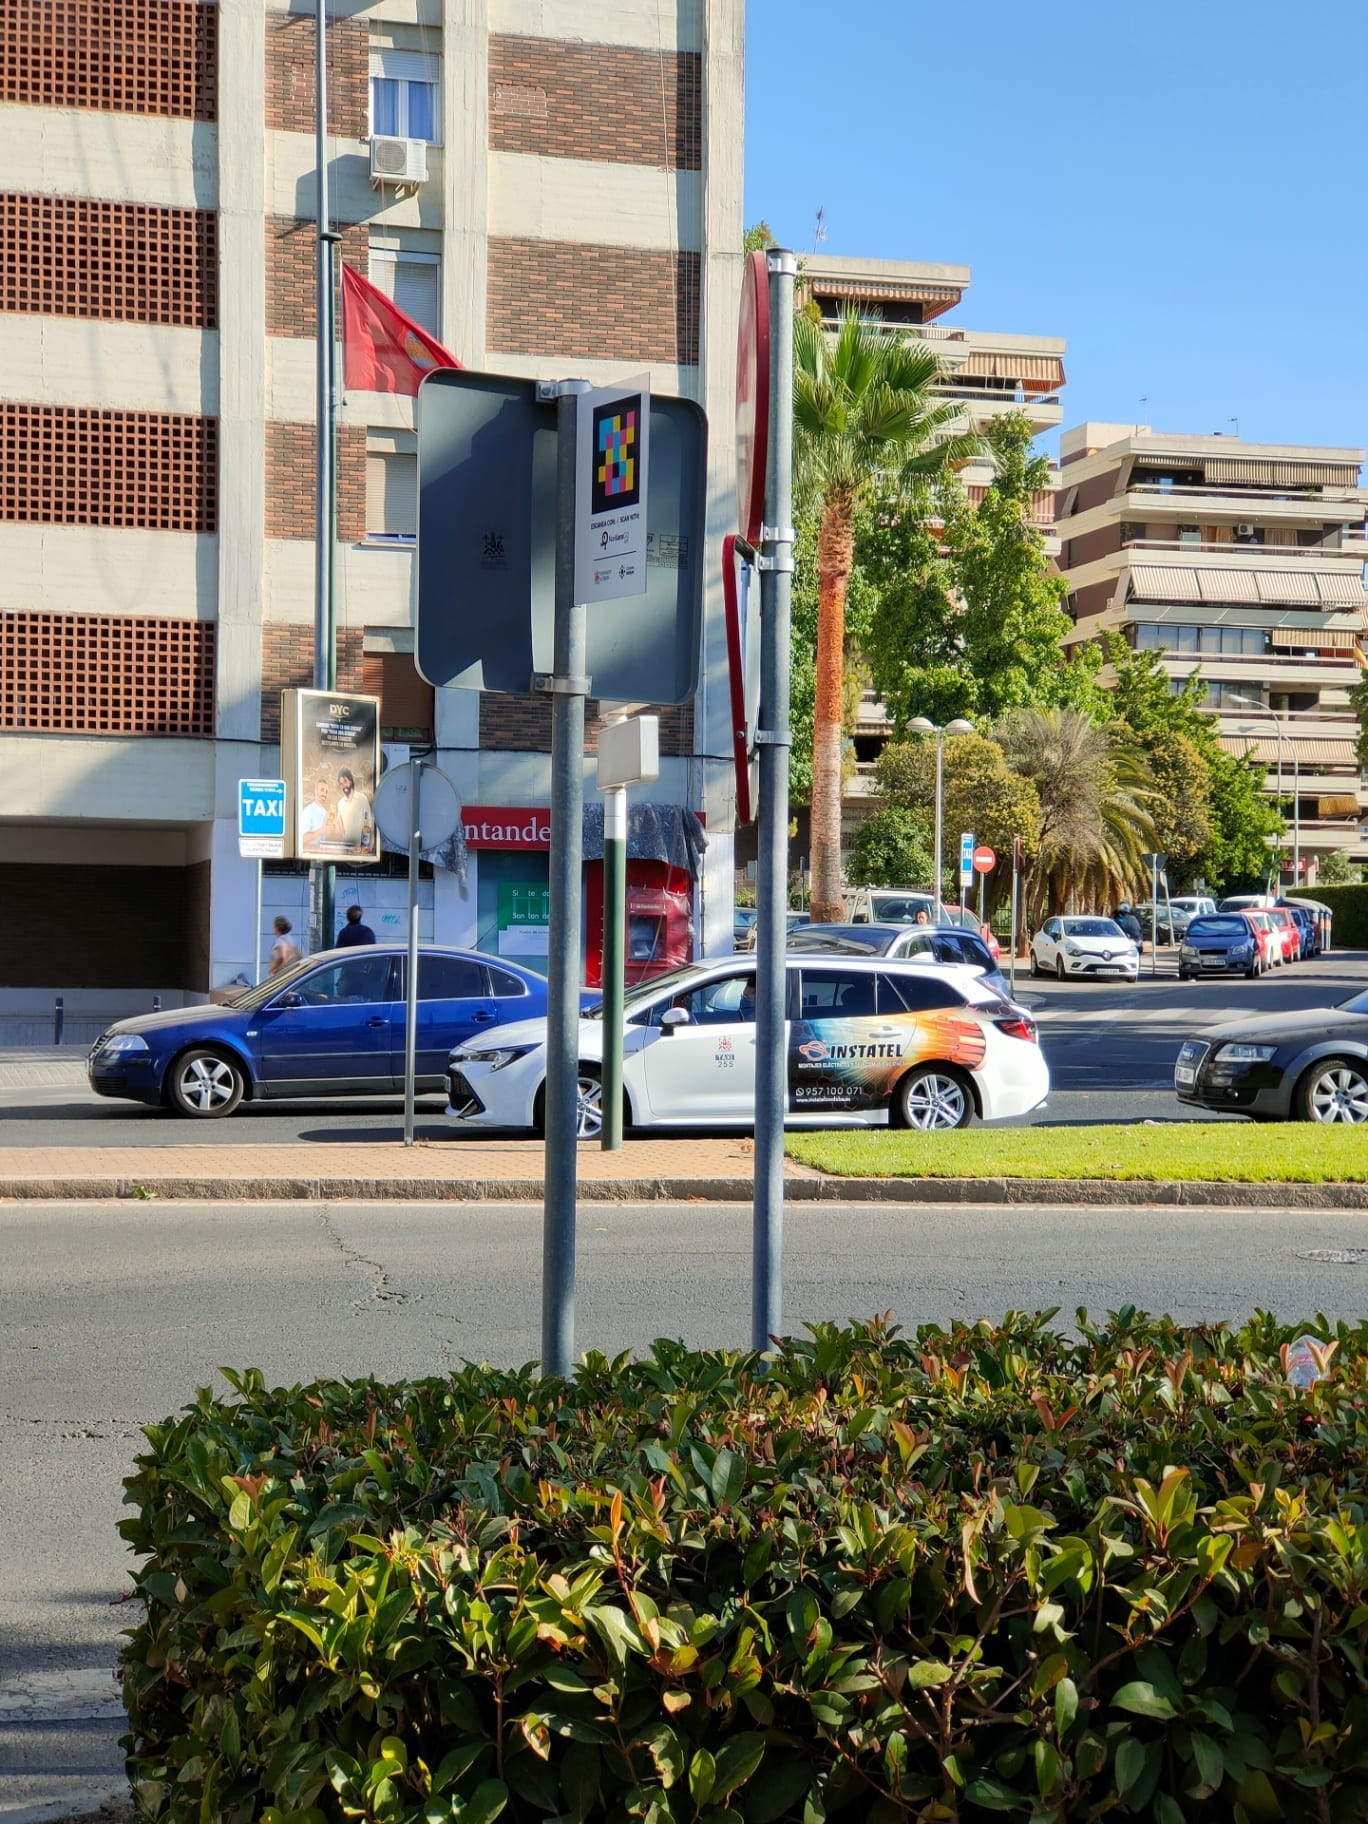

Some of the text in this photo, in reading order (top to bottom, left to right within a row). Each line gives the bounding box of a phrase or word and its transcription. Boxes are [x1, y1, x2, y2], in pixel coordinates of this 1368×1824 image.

[330, 704, 350, 716] DYC
[242, 799, 283, 817] TAXI
[464, 817, 550, 842] ntande
[830, 1043, 903, 1059] INSTATEL
[805, 1086, 862, 1096] 957 100 071
